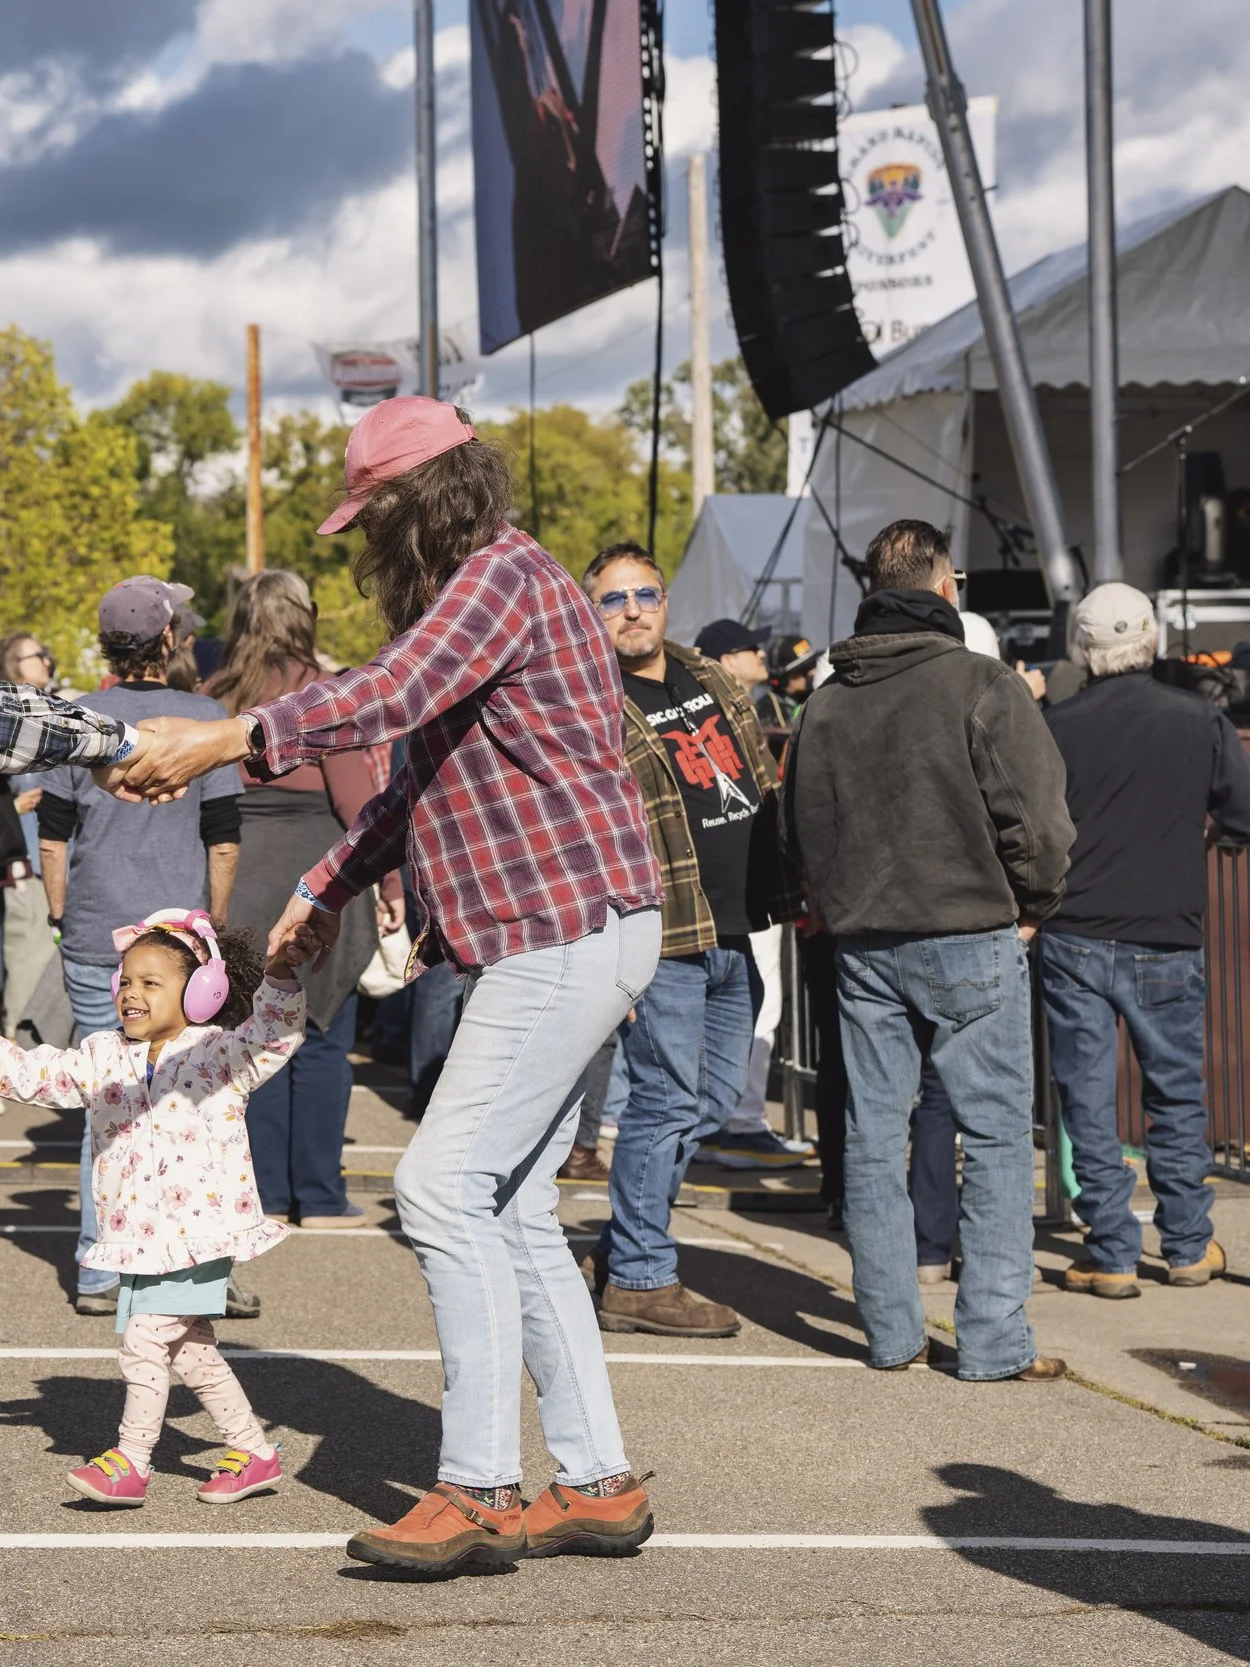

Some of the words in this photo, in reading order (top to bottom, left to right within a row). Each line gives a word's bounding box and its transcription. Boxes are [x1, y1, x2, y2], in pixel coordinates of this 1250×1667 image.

[855, 274, 934, 292] PONSORS
[645, 711, 668, 727] SIC
[682, 693, 714, 713] ROU
